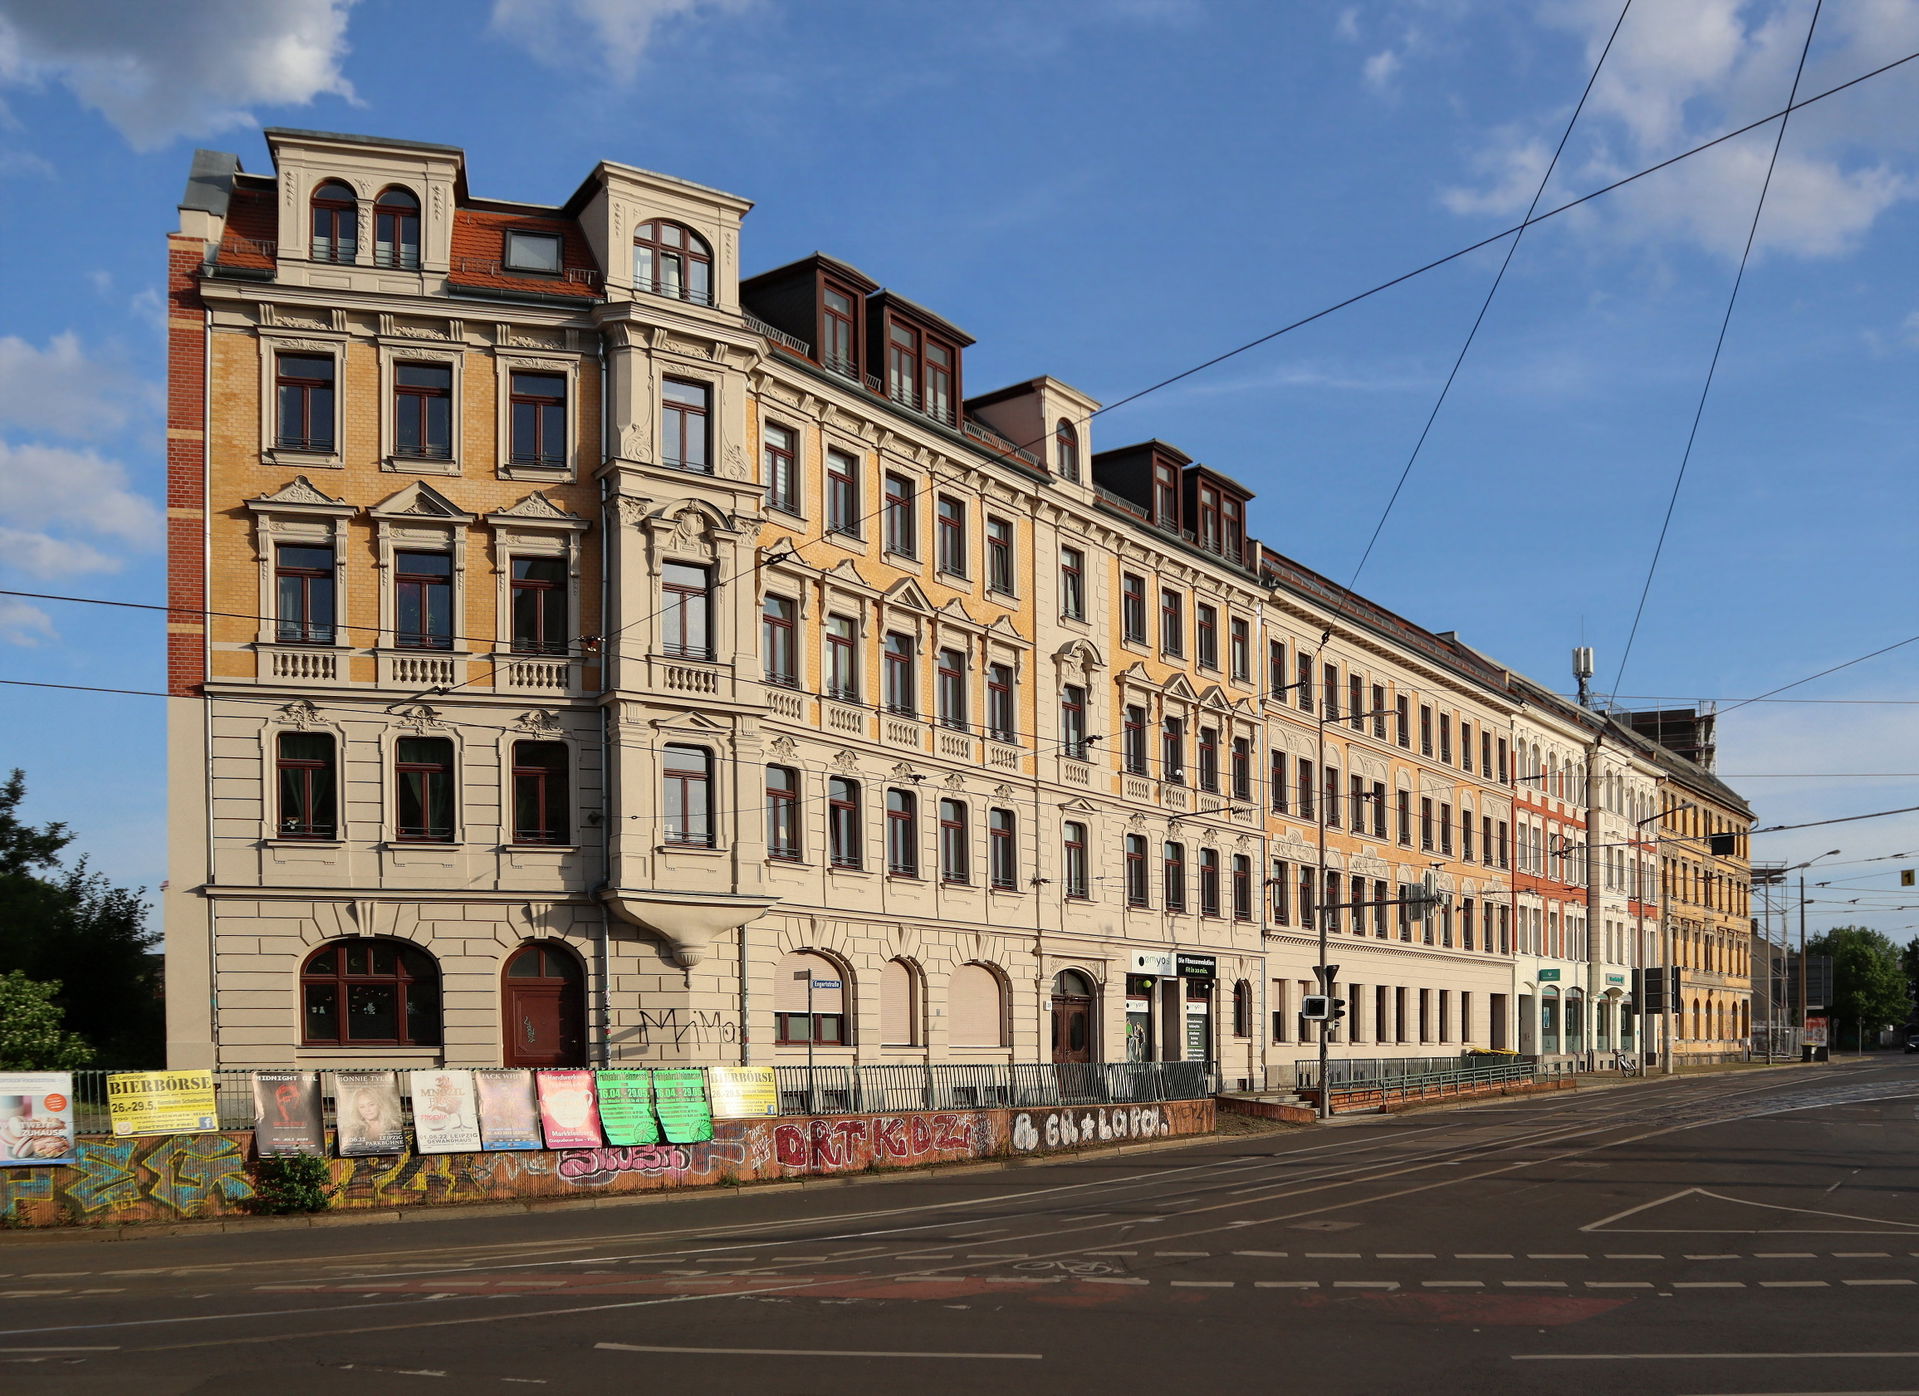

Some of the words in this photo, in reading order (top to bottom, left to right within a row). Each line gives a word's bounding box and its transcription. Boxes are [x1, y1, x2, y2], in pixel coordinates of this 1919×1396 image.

[1904, 872, 1912, 884] 1
[814, 980, 840, 988] Engertstraße
[710, 1070, 774, 1083] BIERBÖRSE
[109, 1075, 212, 1095] BIERBÖRSE
[600, 1088, 621, 1098] 16.04.
[628, 1087, 650, 1098] 29.05.
[112, 1101, 157, 1113] 26.-29.5.
[427, 1137, 472, 1145] GEWANDHAUS
